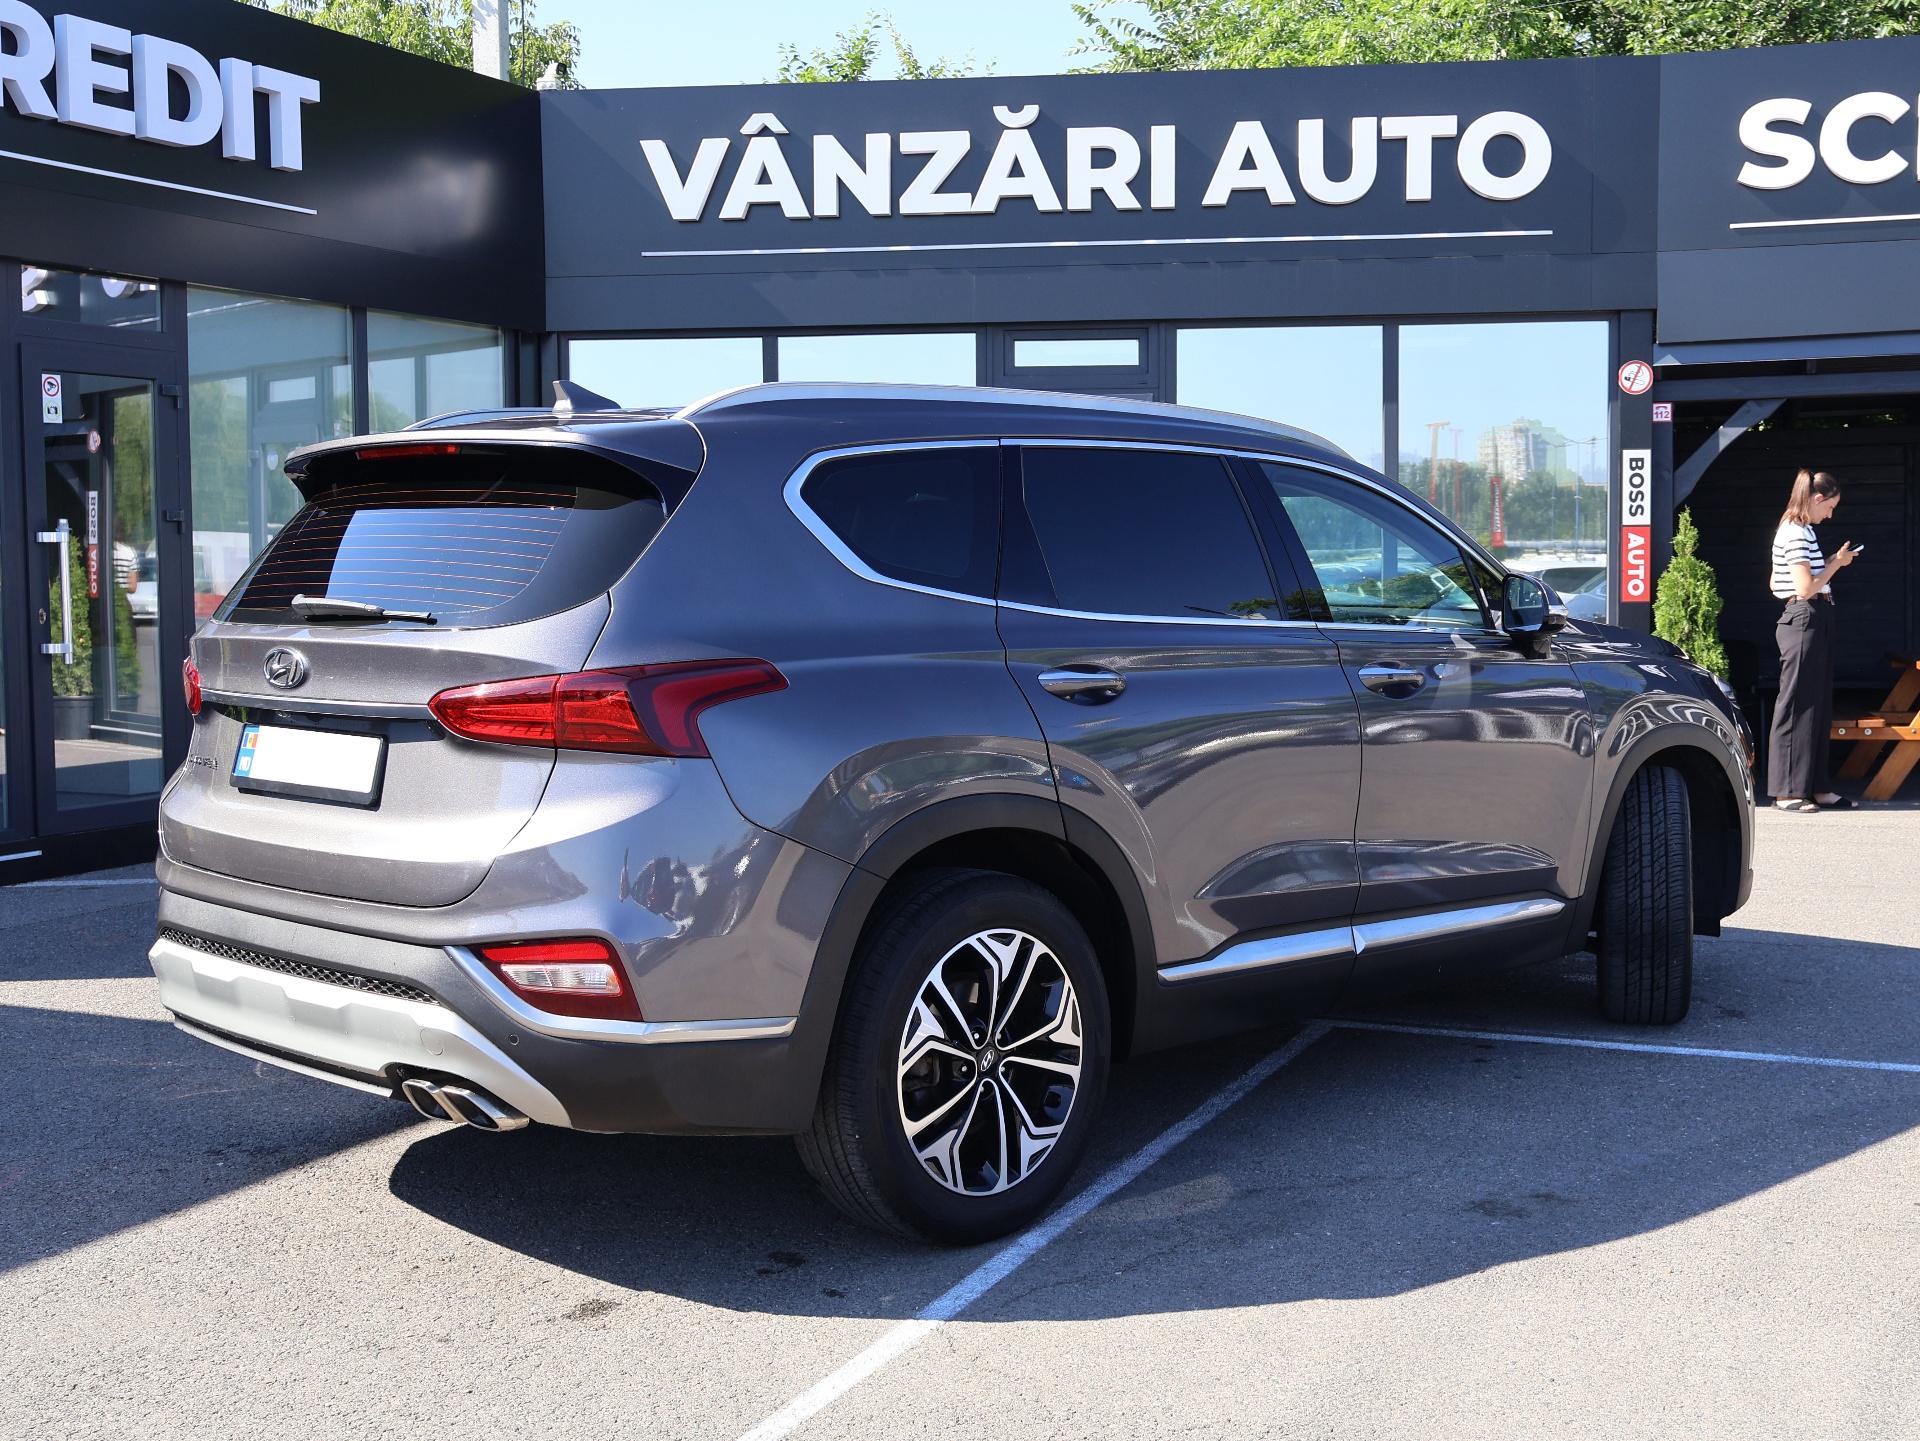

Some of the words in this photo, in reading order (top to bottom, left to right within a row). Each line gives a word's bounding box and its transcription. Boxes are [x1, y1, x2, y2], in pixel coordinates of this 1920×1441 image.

[639, 104, 1176, 222] VÂNZĂRI
[1201, 111, 1553, 206] AUTO
[1737, 91, 1920, 190] SC
[1654, 410, 1670, 419] 112
[1629, 457, 1645, 517] BOSS
[1627, 532, 1645, 597] AUTO
